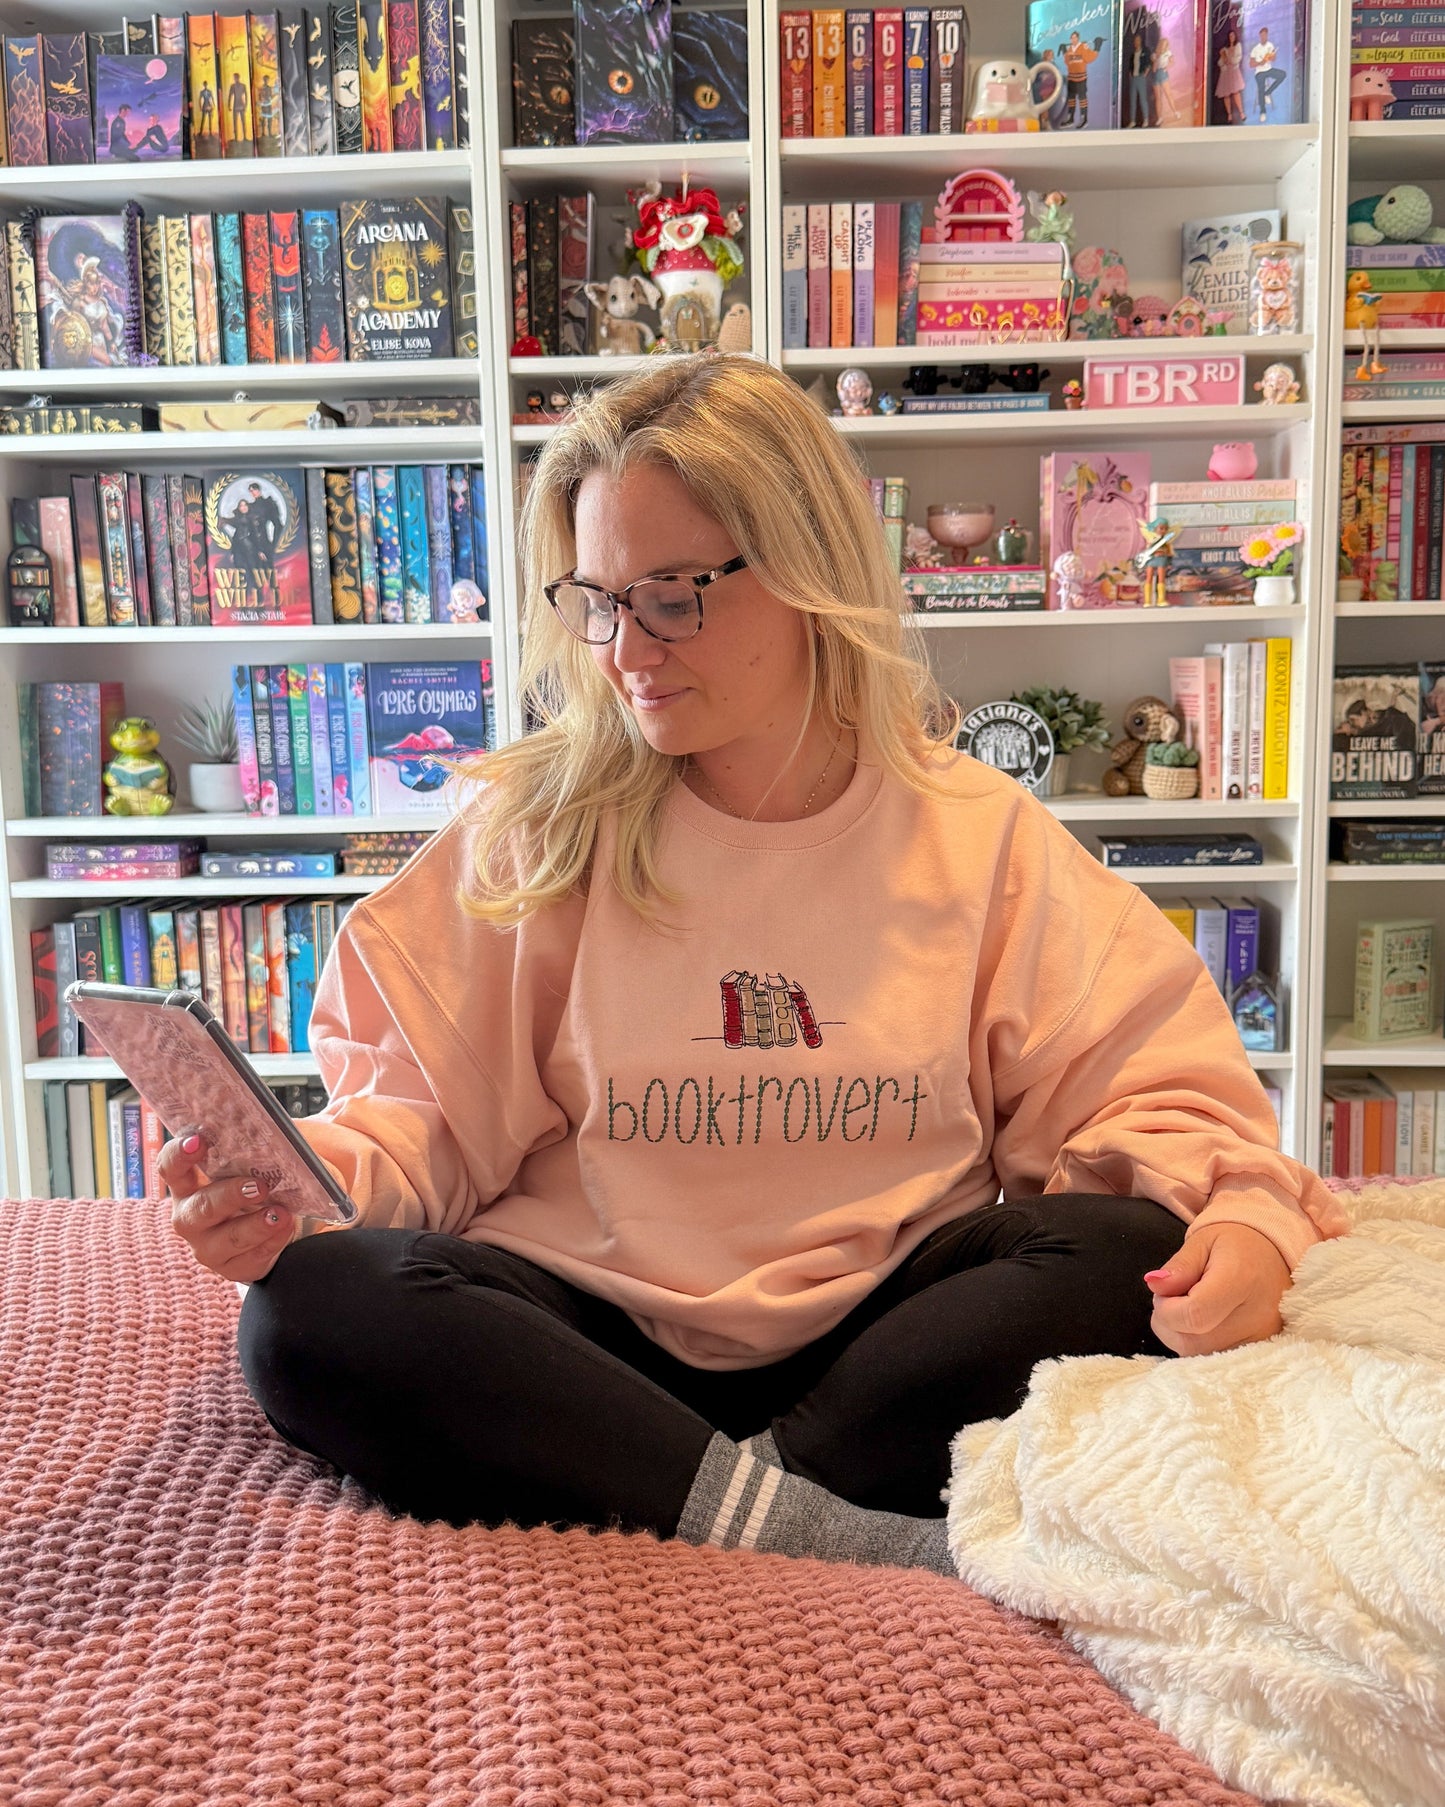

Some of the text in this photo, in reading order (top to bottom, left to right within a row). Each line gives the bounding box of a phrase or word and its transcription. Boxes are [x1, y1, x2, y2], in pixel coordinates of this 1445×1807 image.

[1379, 11, 1404, 26] Score
[1412, 14, 1427, 24] ELLE
[784, 27, 809, 60] 13
[815, 25, 840, 57] 13
[852, 25, 866, 57] 6
[882, 25, 895, 57] 6
[910, 23, 923, 55] 7
[936, 22, 959, 54] 10
[1380, 30, 1400, 43] Goal
[1410, 33, 1426, 42] ELLE
[1374, 49, 1404, 62] Legacy
[1410, 51, 1426, 60] ELLE
[1410, 68, 1426, 77] ELLE
[1411, 87, 1427, 96] ELLE
[1410, 107, 1427, 116] ELLE
[357, 221, 429, 245] ARCANA
[794, 225, 802, 250] MILE
[834, 235, 841, 250] UP
[841, 220, 849, 264] CAUGHT
[857, 224, 865, 263] ALONG
[818, 229, 826, 262] RIGHT
[357, 310, 442, 332] ACADEMY
[371, 336, 432, 351] ELISE KOVA
[1093, 362, 1236, 406] TBR RD
[1379, 387, 1409, 398] LOGAN
[1202, 486, 1253, 498] KNOT ALL IS
[1224, 508, 1240, 519] ALL
[1241, 507, 1250, 519] IS
[1201, 552, 1224, 563] KNOT
[215, 568, 247, 588] WE
[215, 588, 264, 608] WILL
[230, 611, 287, 621] STACIA STARK
[391, 677, 423, 685] RACHEL
[377, 688, 477, 720] LORE OLYMPUS
[1273, 655, 1287, 768] KOONTZ VELOCITY
[960, 705, 1042, 735] Tatiana's
[1350, 736, 1398, 751] LEAVE ME
[1331, 751, 1414, 782] BEHIND
[608, 1074, 928, 1147] booktrovert
